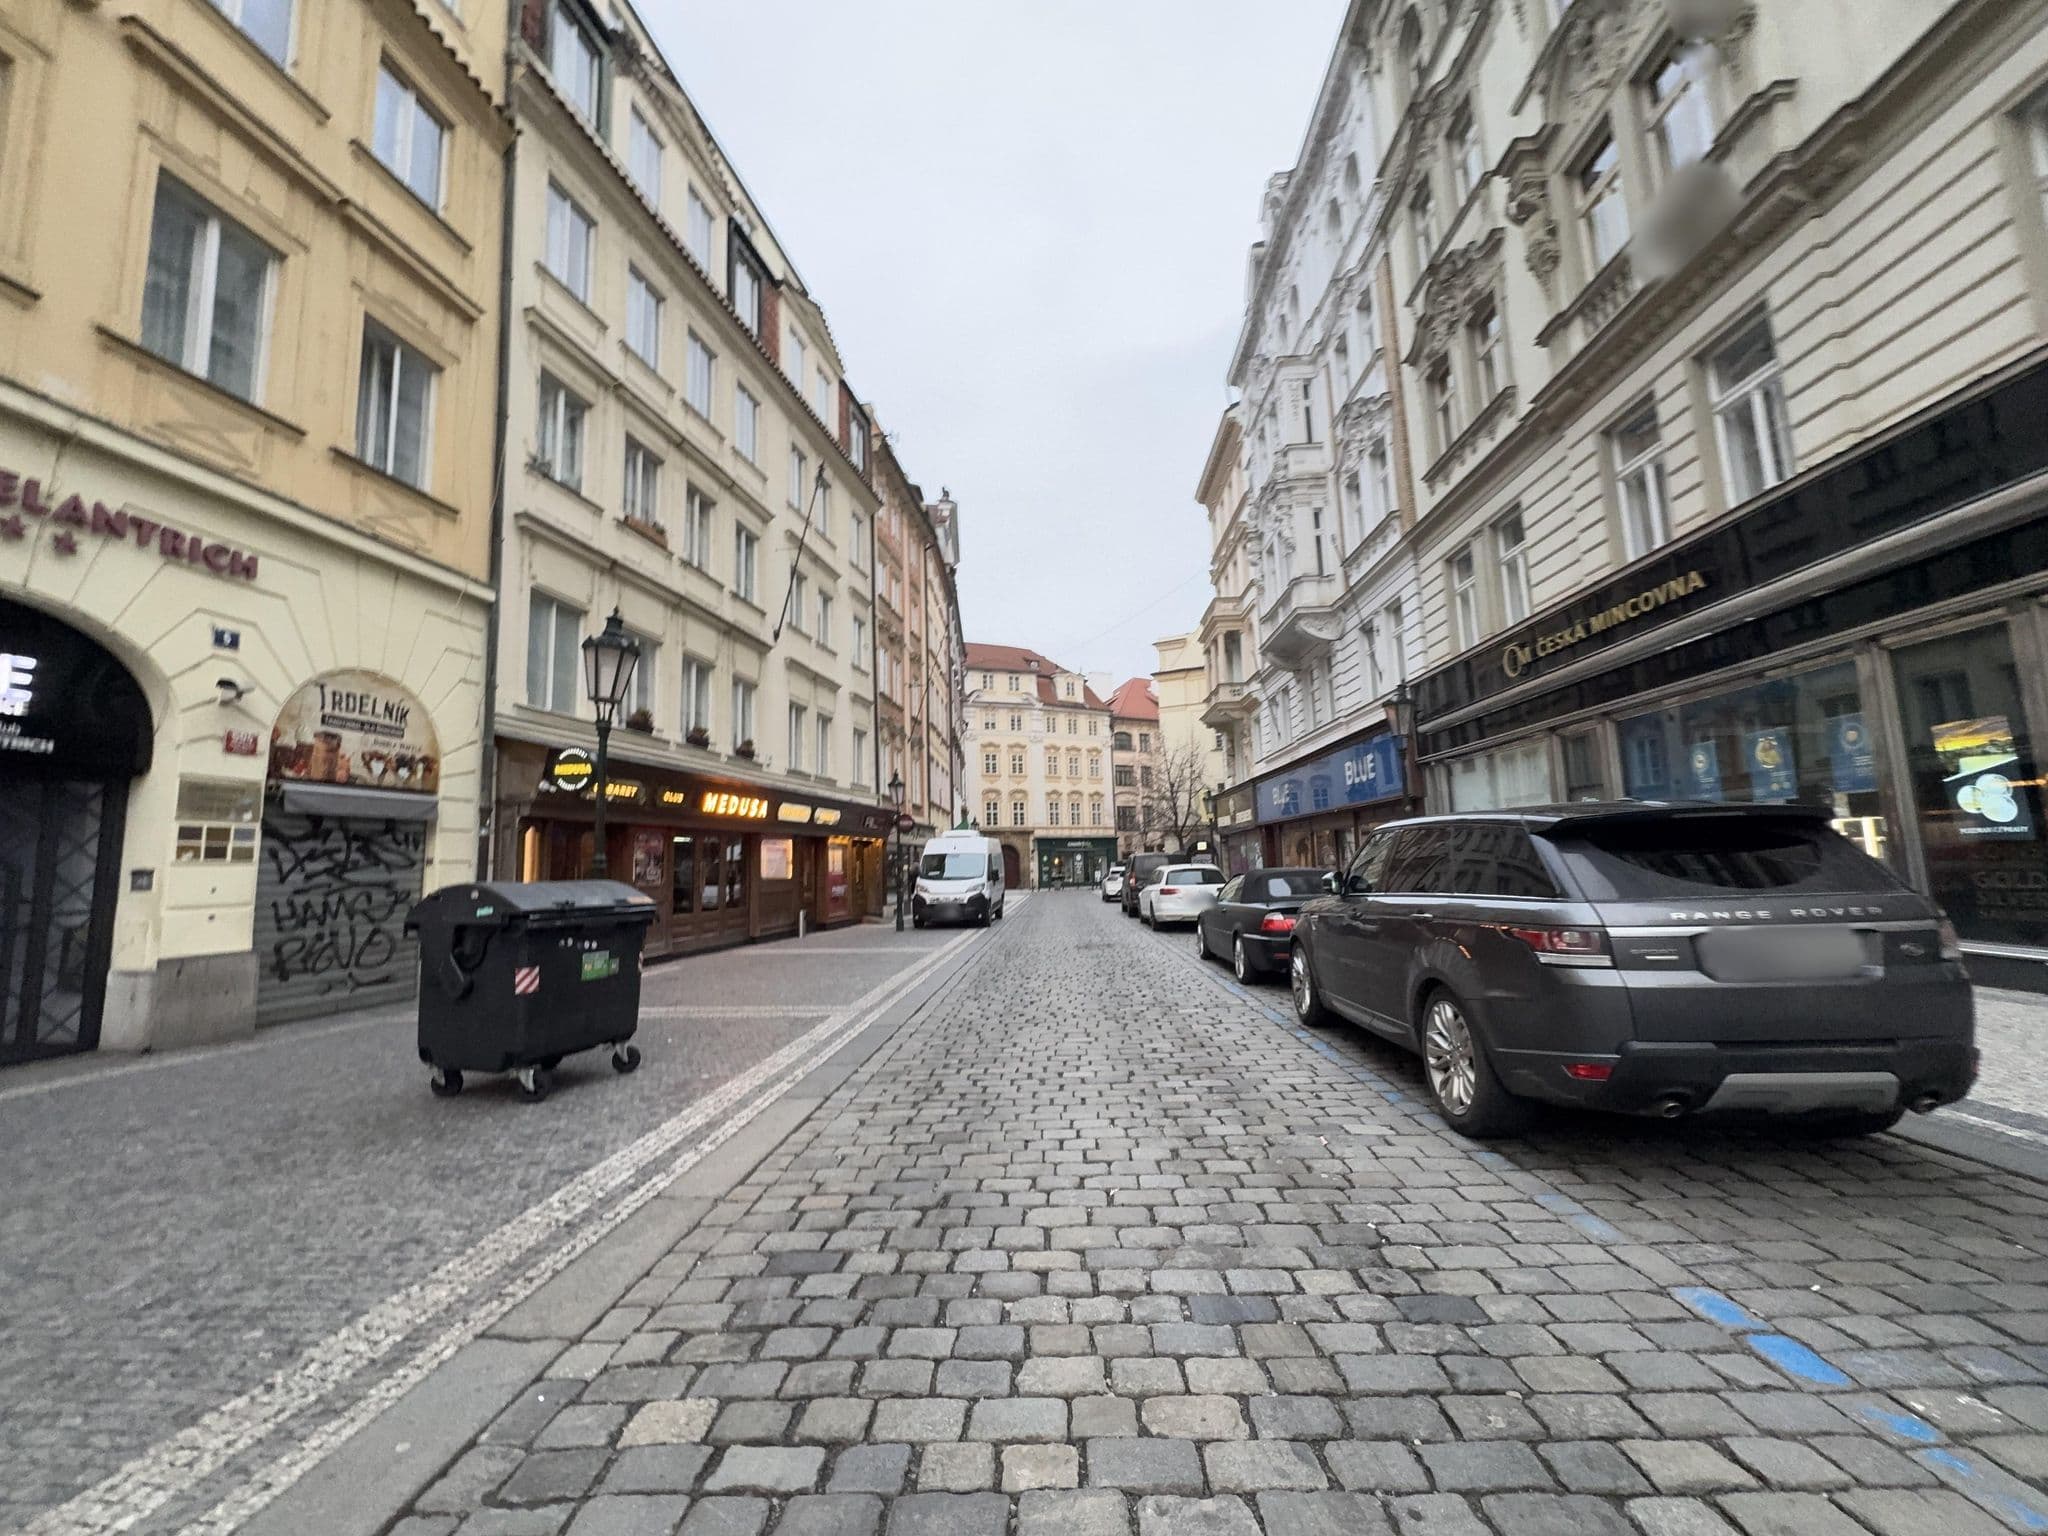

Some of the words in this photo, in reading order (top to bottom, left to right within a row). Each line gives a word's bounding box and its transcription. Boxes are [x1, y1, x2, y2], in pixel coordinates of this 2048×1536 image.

[1589, 570, 1706, 634] MINCOVNA
[1344, 752, 1377, 786] BLUE
[702, 791, 769, 820] MEDUSA
[1669, 910, 1773, 921] RANGE
[1789, 906, 1884, 919] ROVER
